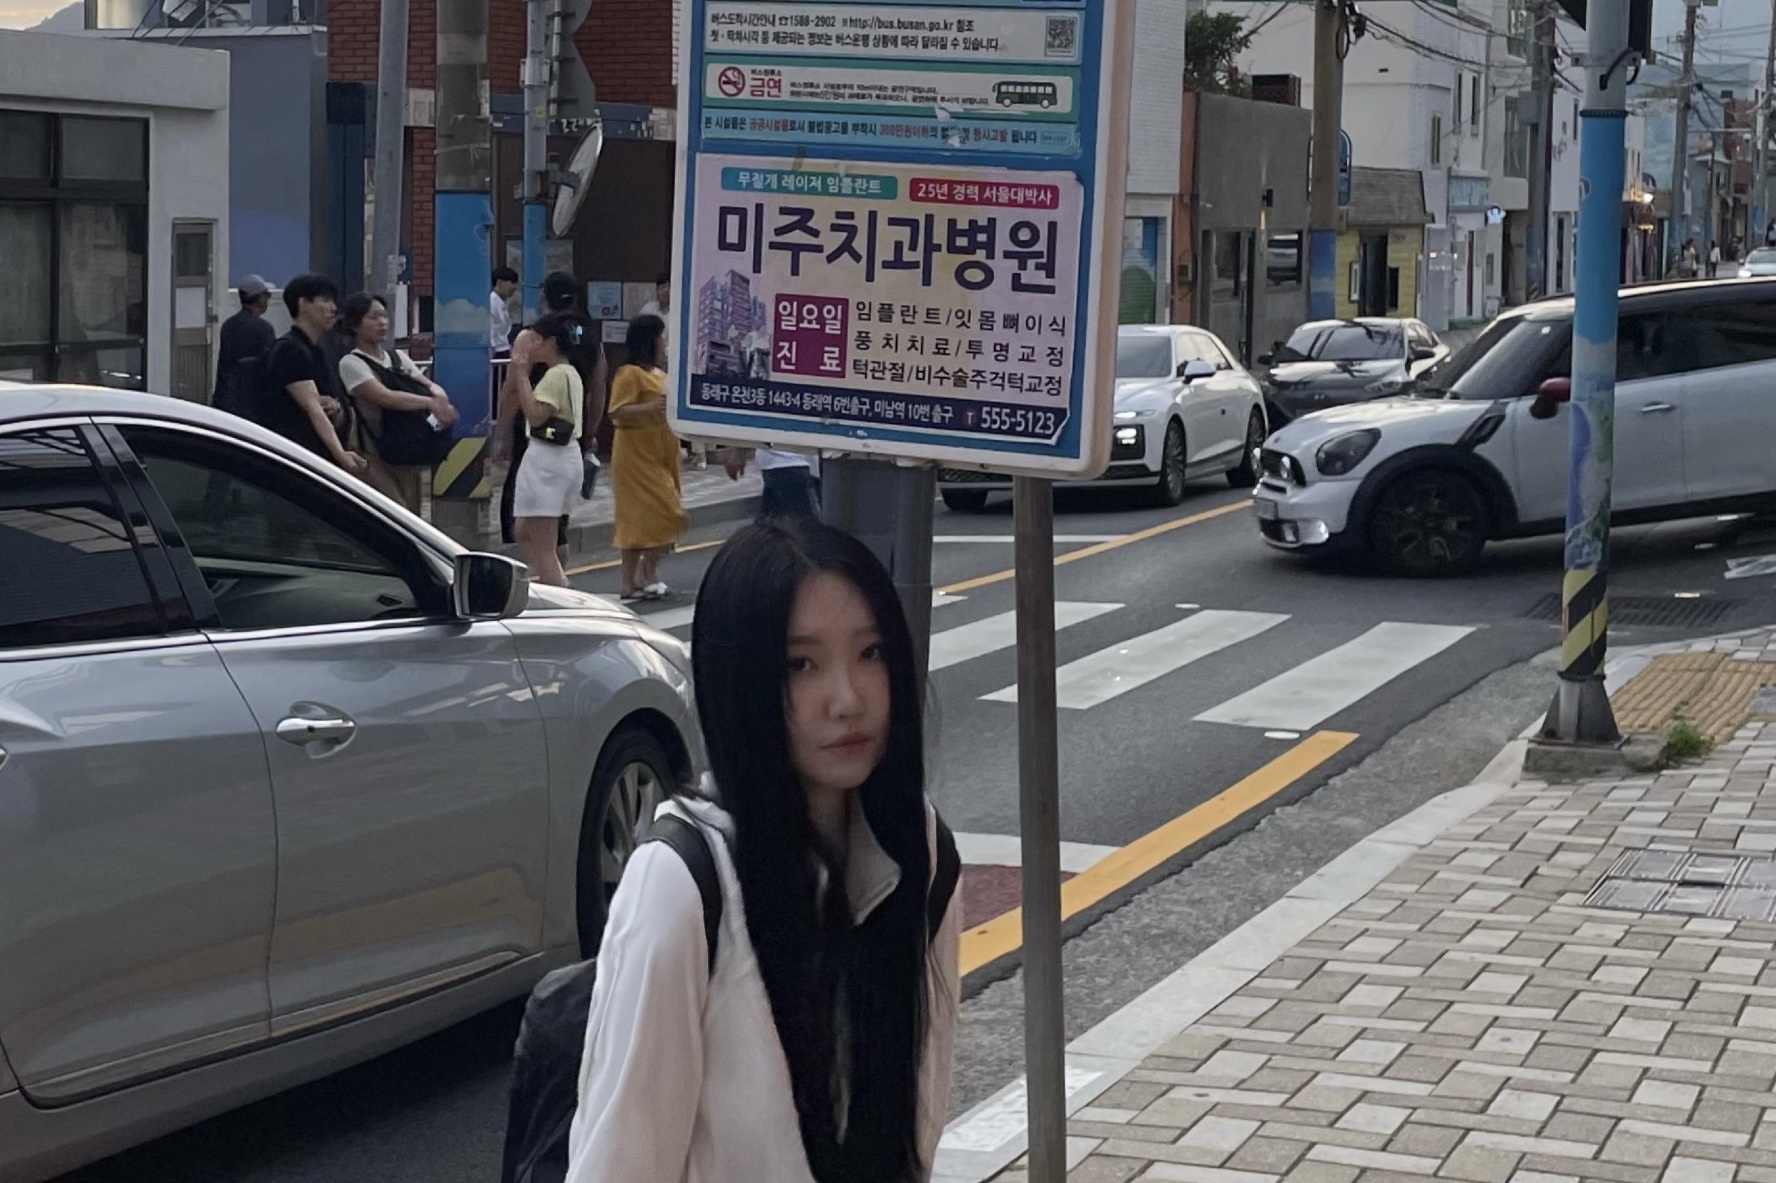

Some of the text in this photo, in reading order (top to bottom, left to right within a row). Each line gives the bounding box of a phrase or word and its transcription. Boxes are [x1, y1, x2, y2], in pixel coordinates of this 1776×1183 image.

[790, 15, 836, 28] 1588-2902
[956, 18, 975, 33] 참조
[761, 31, 769, 44] 등
[772, 31, 805, 45] 제공되는
[808, 32, 832, 46] 정보는
[835, 33, 869, 48] 버스운행
[872, 34, 898, 48] 상황에
[901, 35, 919, 49] 따라
[921, 35, 948, 50] 달라질
[950, 36, 960, 50] 수
[750, 78, 781, 98] 금연
[705, 116, 712, 129] 본
[715, 116, 747, 130] 시설물은
[1011, 129, 1037, 144] 됩니다
[738, 171, 882, 195] 무절개 레이저 임플란트
[917, 182, 1052, 206] 25년 경력 서울대박사
[718, 202, 1058, 295] 미주치과병원
[778, 301, 842, 335] 일요일
[701, 382, 730, 403] 동래구
[731, 385, 767, 406] 온천3동
[768, 389, 801, 408] 1443-4
[802, 392, 832, 413] 동래역
[874, 399, 905, 420] 미남역
[980, 406, 1055, 435] 555-5123
